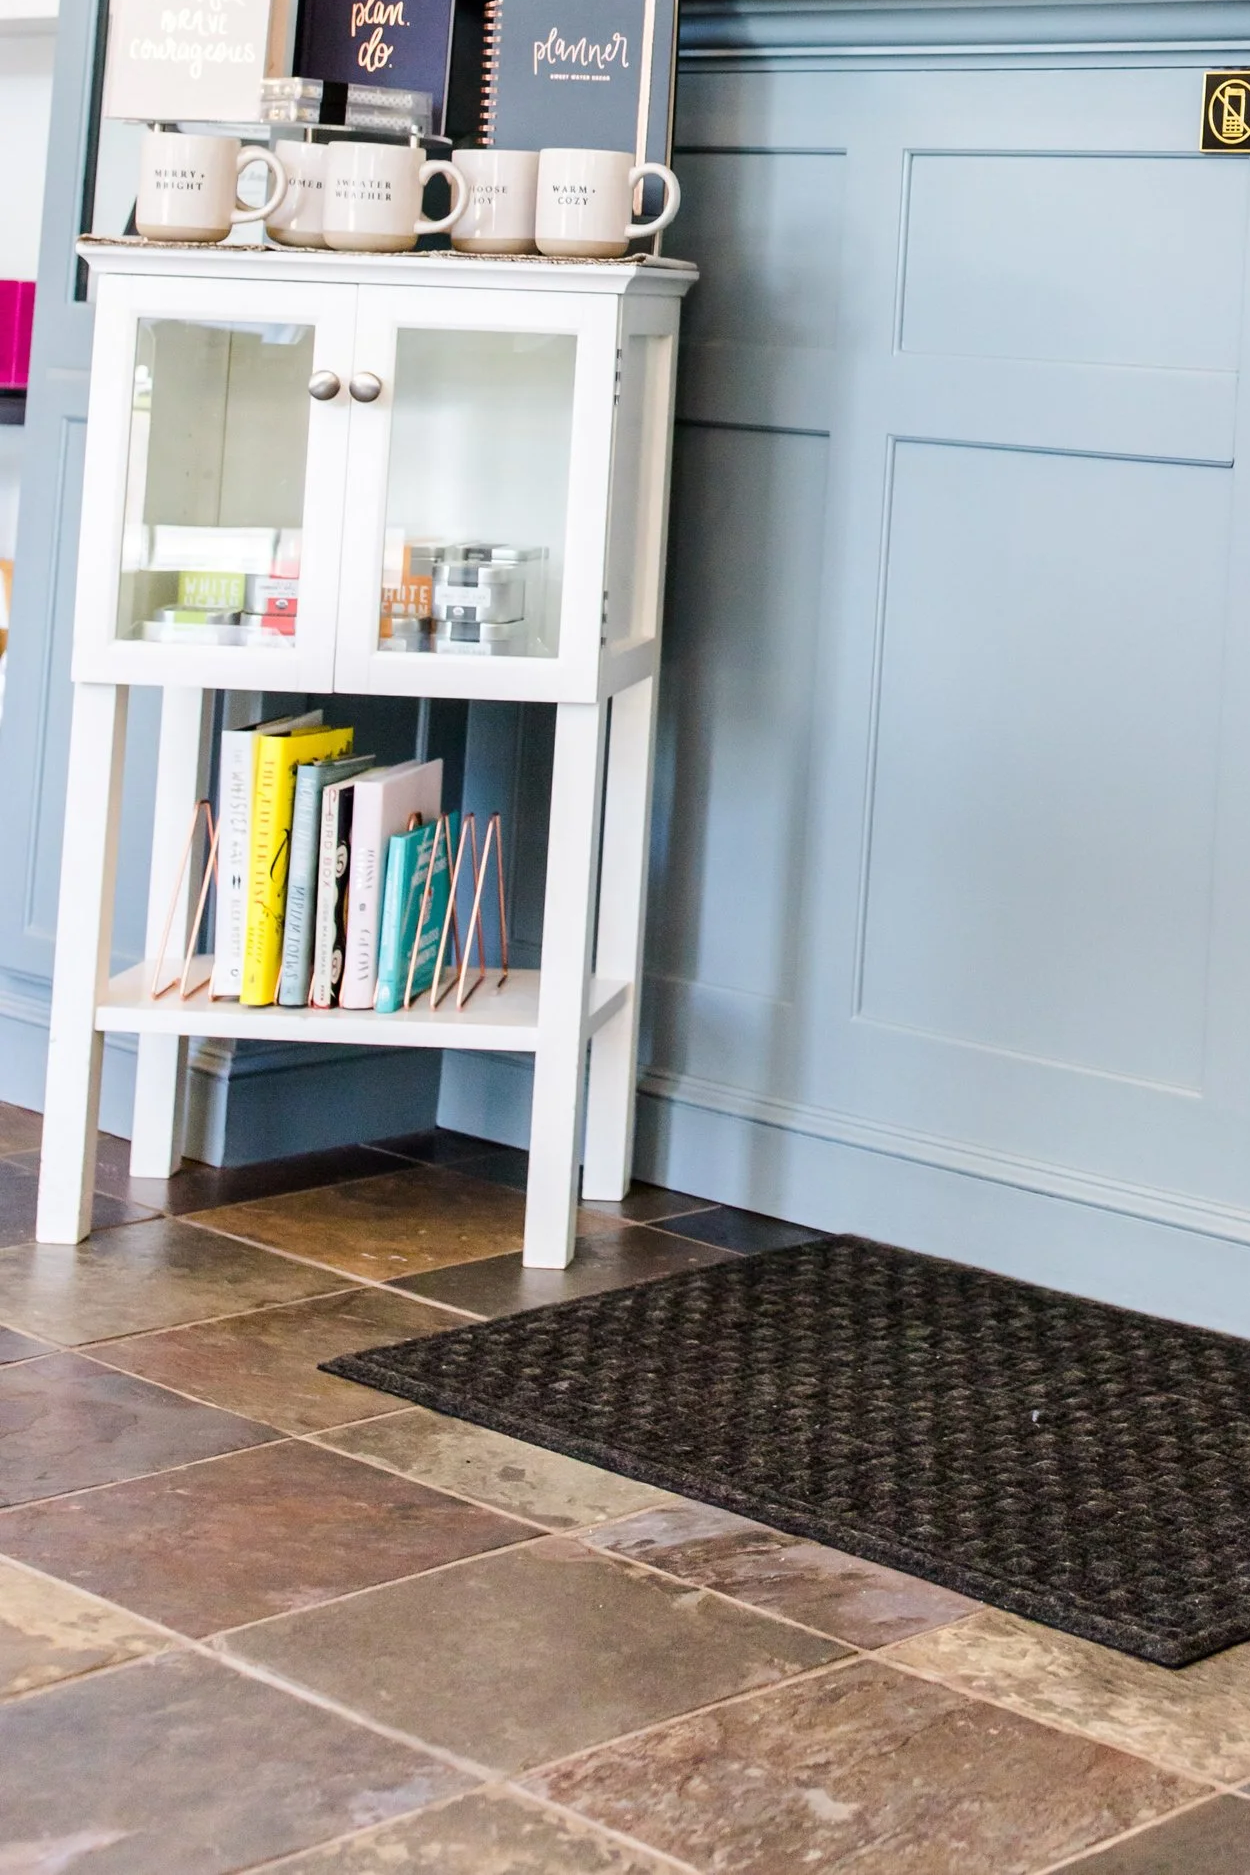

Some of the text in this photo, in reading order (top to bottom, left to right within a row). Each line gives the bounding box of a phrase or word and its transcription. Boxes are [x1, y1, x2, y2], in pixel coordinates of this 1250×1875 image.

[358, 27, 394, 72] do.
[533, 26, 630, 75] planner
[129, 37, 256, 79] courageous
[155, 169, 196, 179] MERRY
[156, 181, 204, 191] BRIGHT
[336, 180, 392, 190] SWEATER
[552, 185, 587, 194] WARM
[335, 191, 393, 202] WEATHER
[558, 197, 589, 206] COZY
[185, 577, 241, 597] WHITE
[322, 813, 335, 889] BIRD BOX
